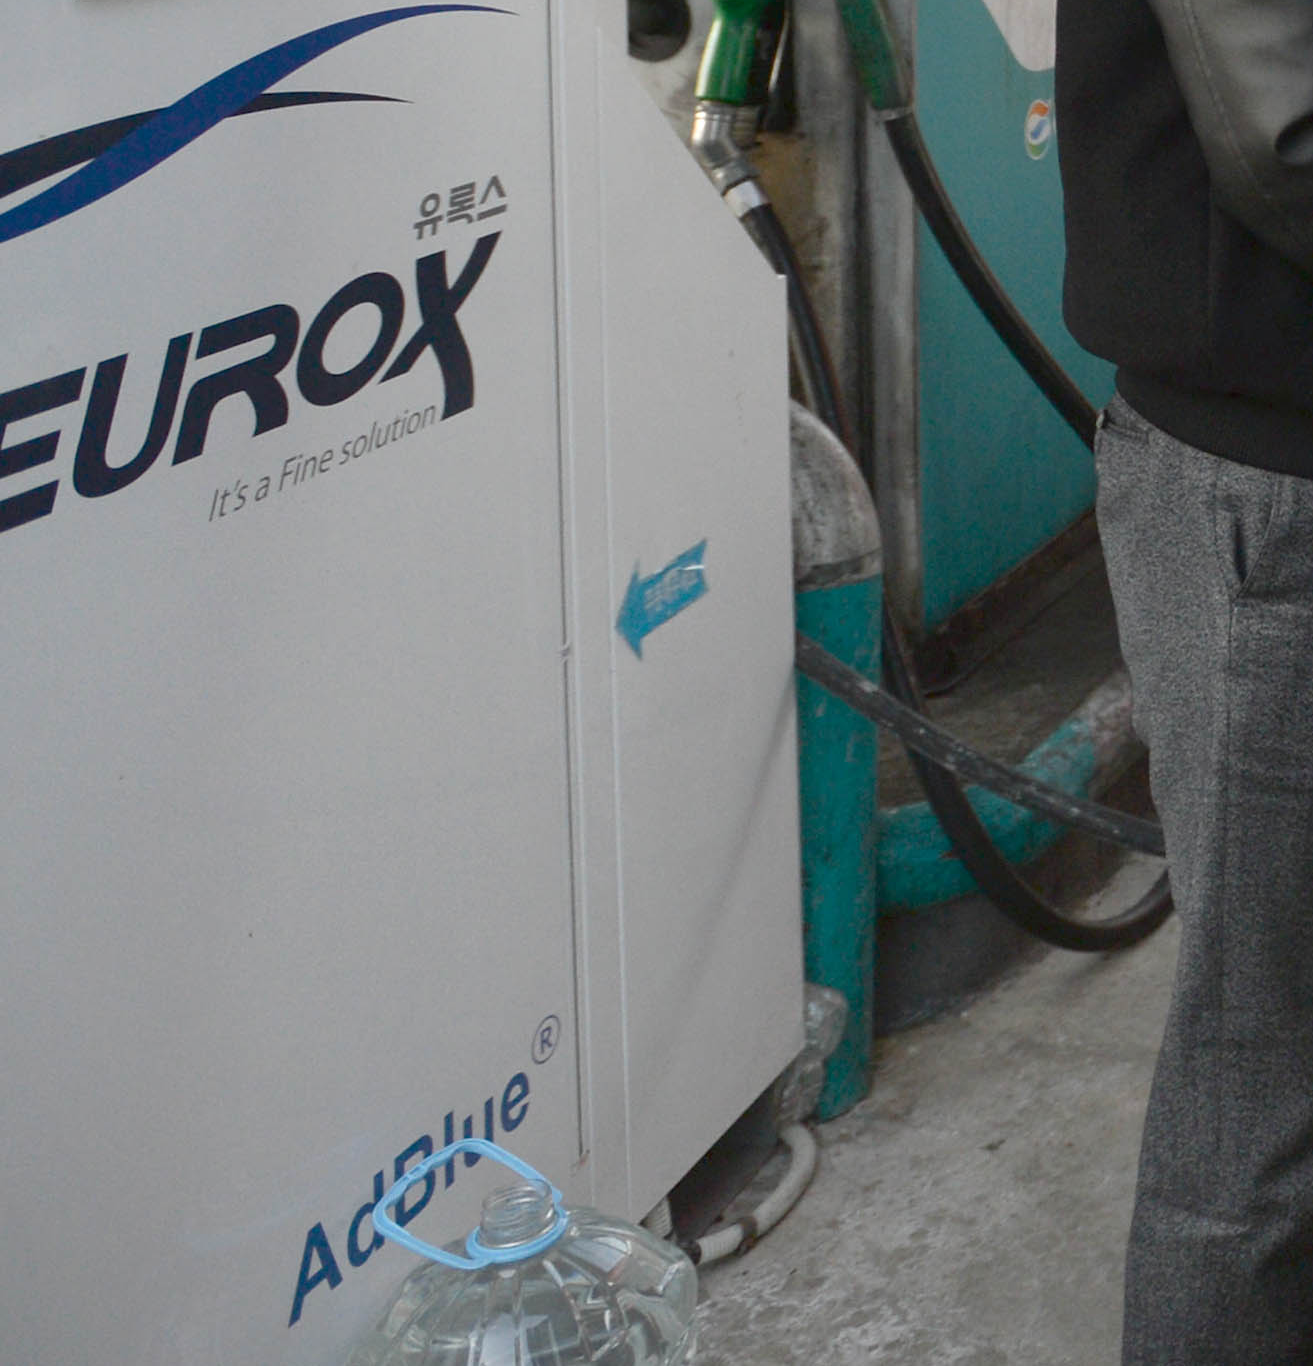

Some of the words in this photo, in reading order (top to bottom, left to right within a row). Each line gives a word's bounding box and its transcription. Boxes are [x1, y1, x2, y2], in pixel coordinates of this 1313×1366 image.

[412, 174, 508, 240] 유록스
[0, 230, 503, 534] EUROX
[254, 473, 271, 502] a
[278, 444, 334, 492] Fine
[338, 404, 437, 464] solution
